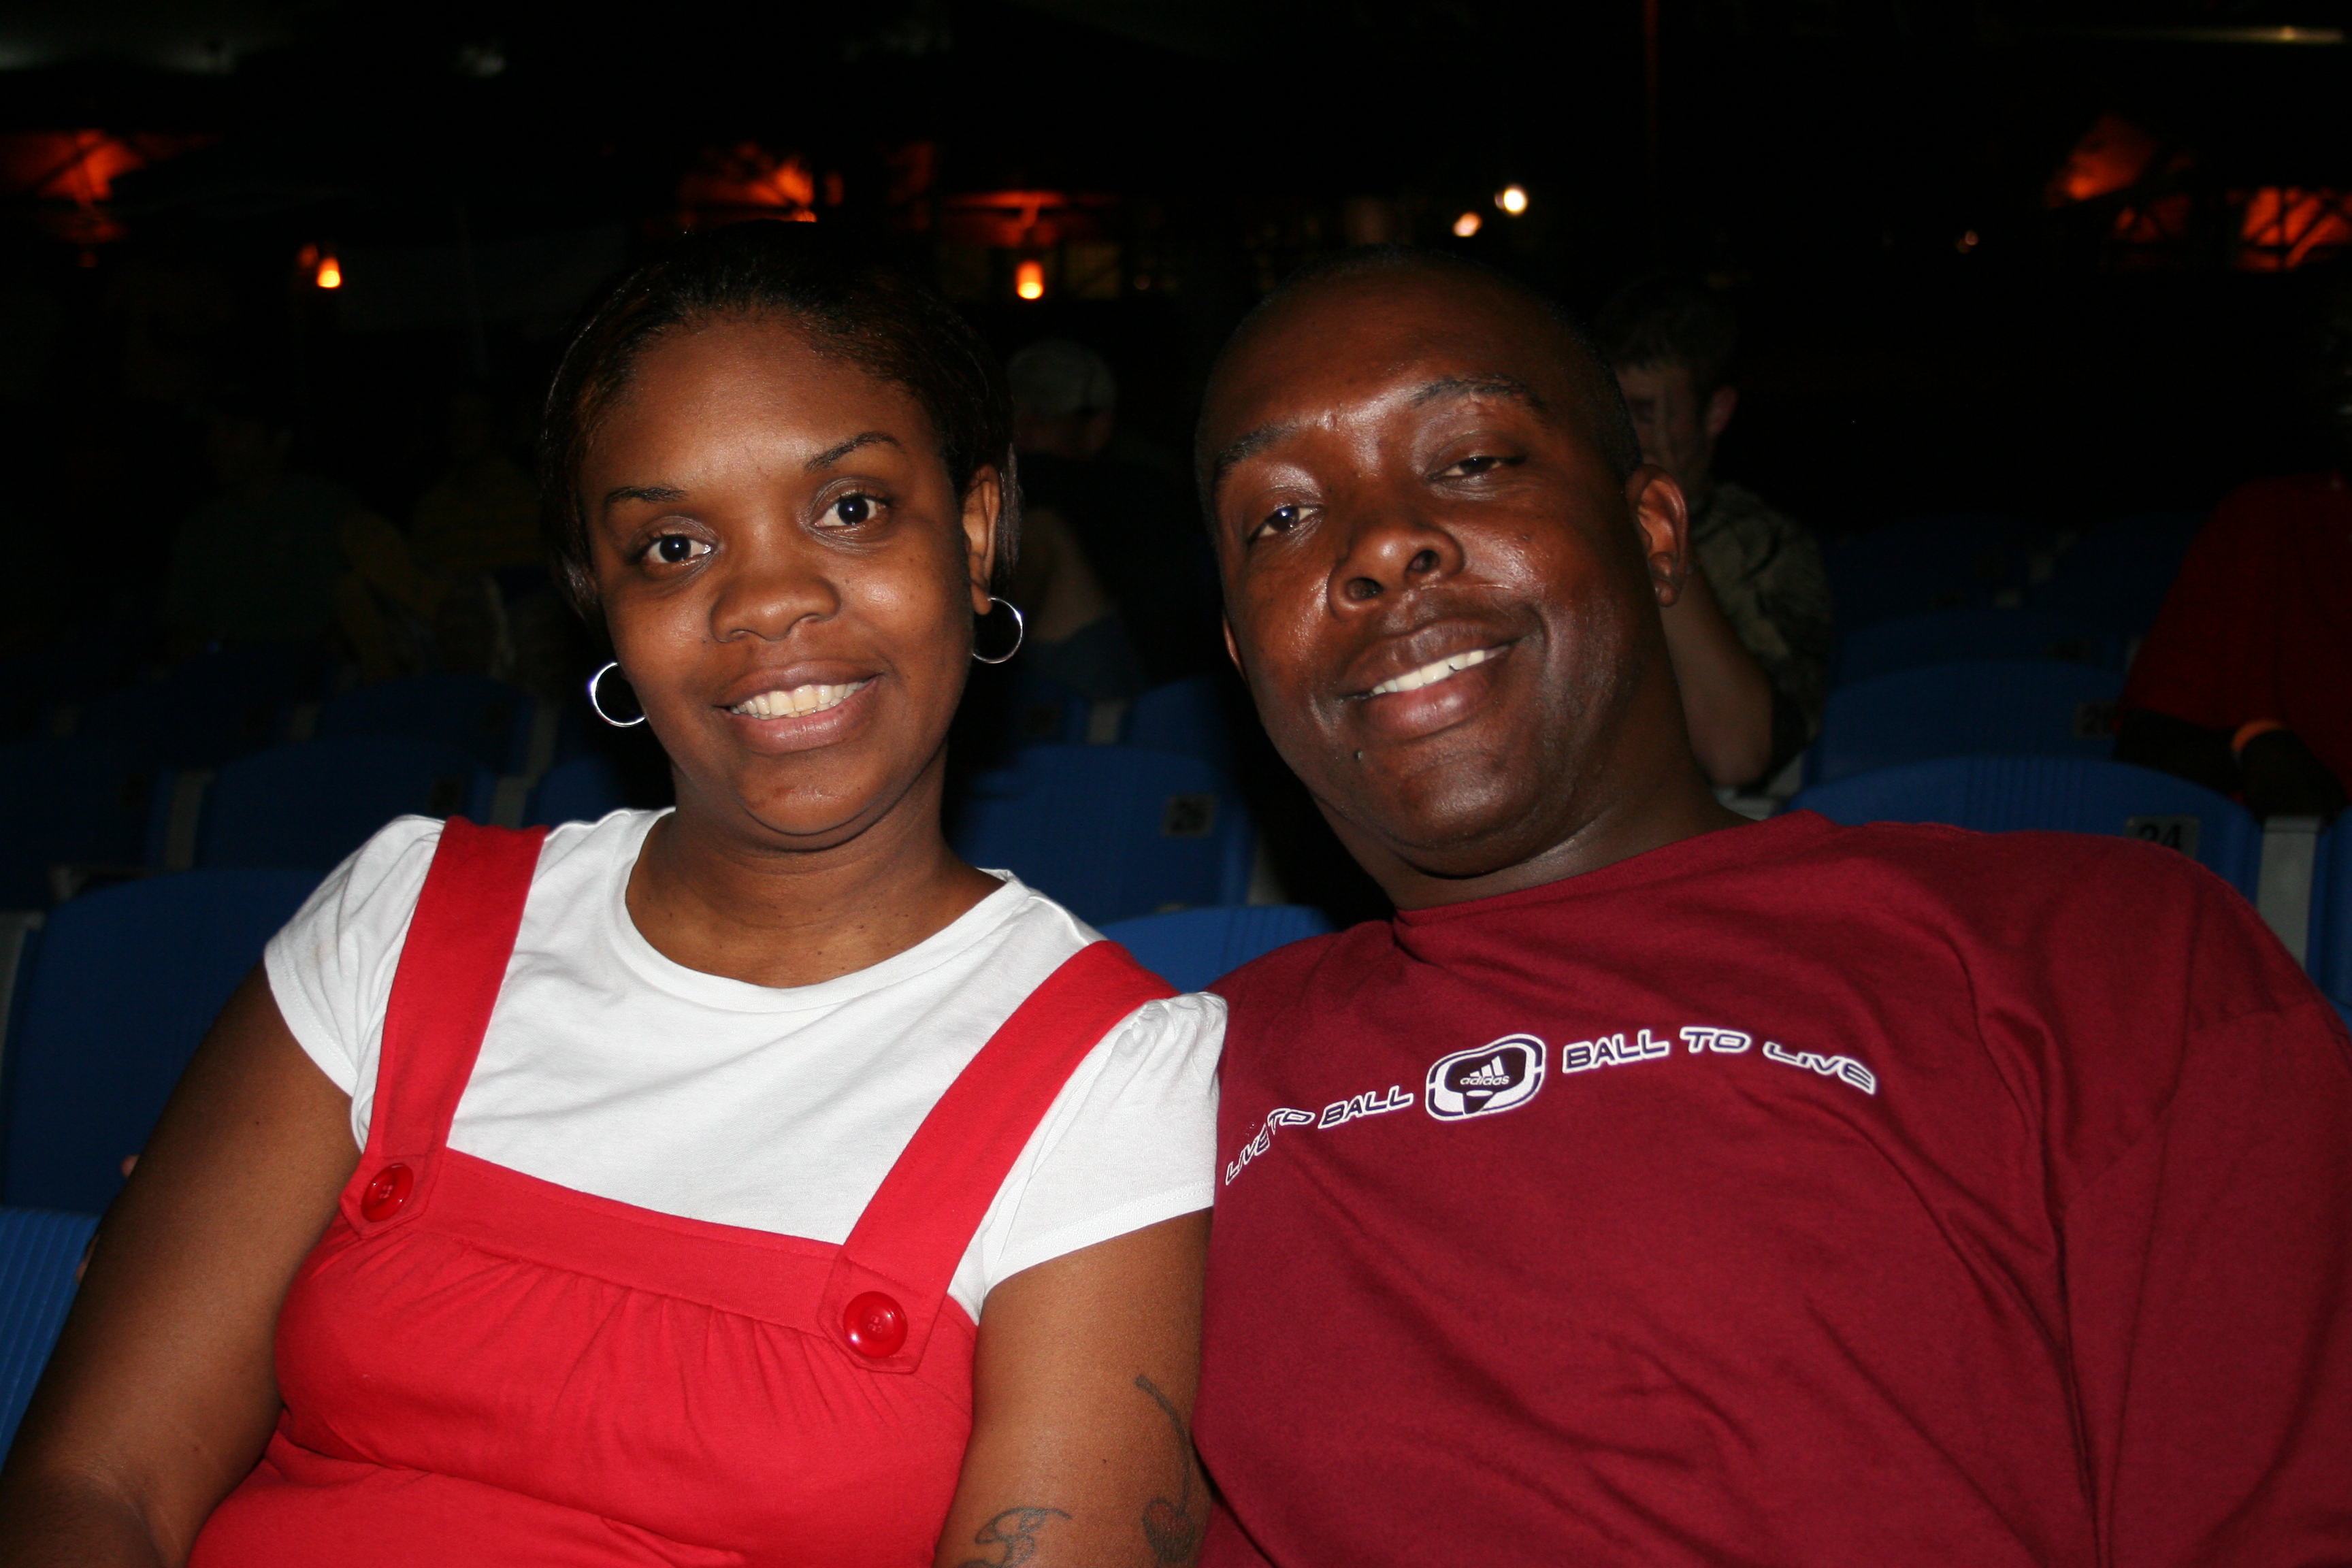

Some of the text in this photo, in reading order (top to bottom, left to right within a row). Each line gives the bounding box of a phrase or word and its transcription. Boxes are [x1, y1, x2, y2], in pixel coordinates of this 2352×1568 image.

[1460, 1075, 1510, 1086] adidas
[1562, 1026, 1876, 1095] BALL TO LIVE
[1225, 1085, 1414, 1186] LIVE TO BALL
